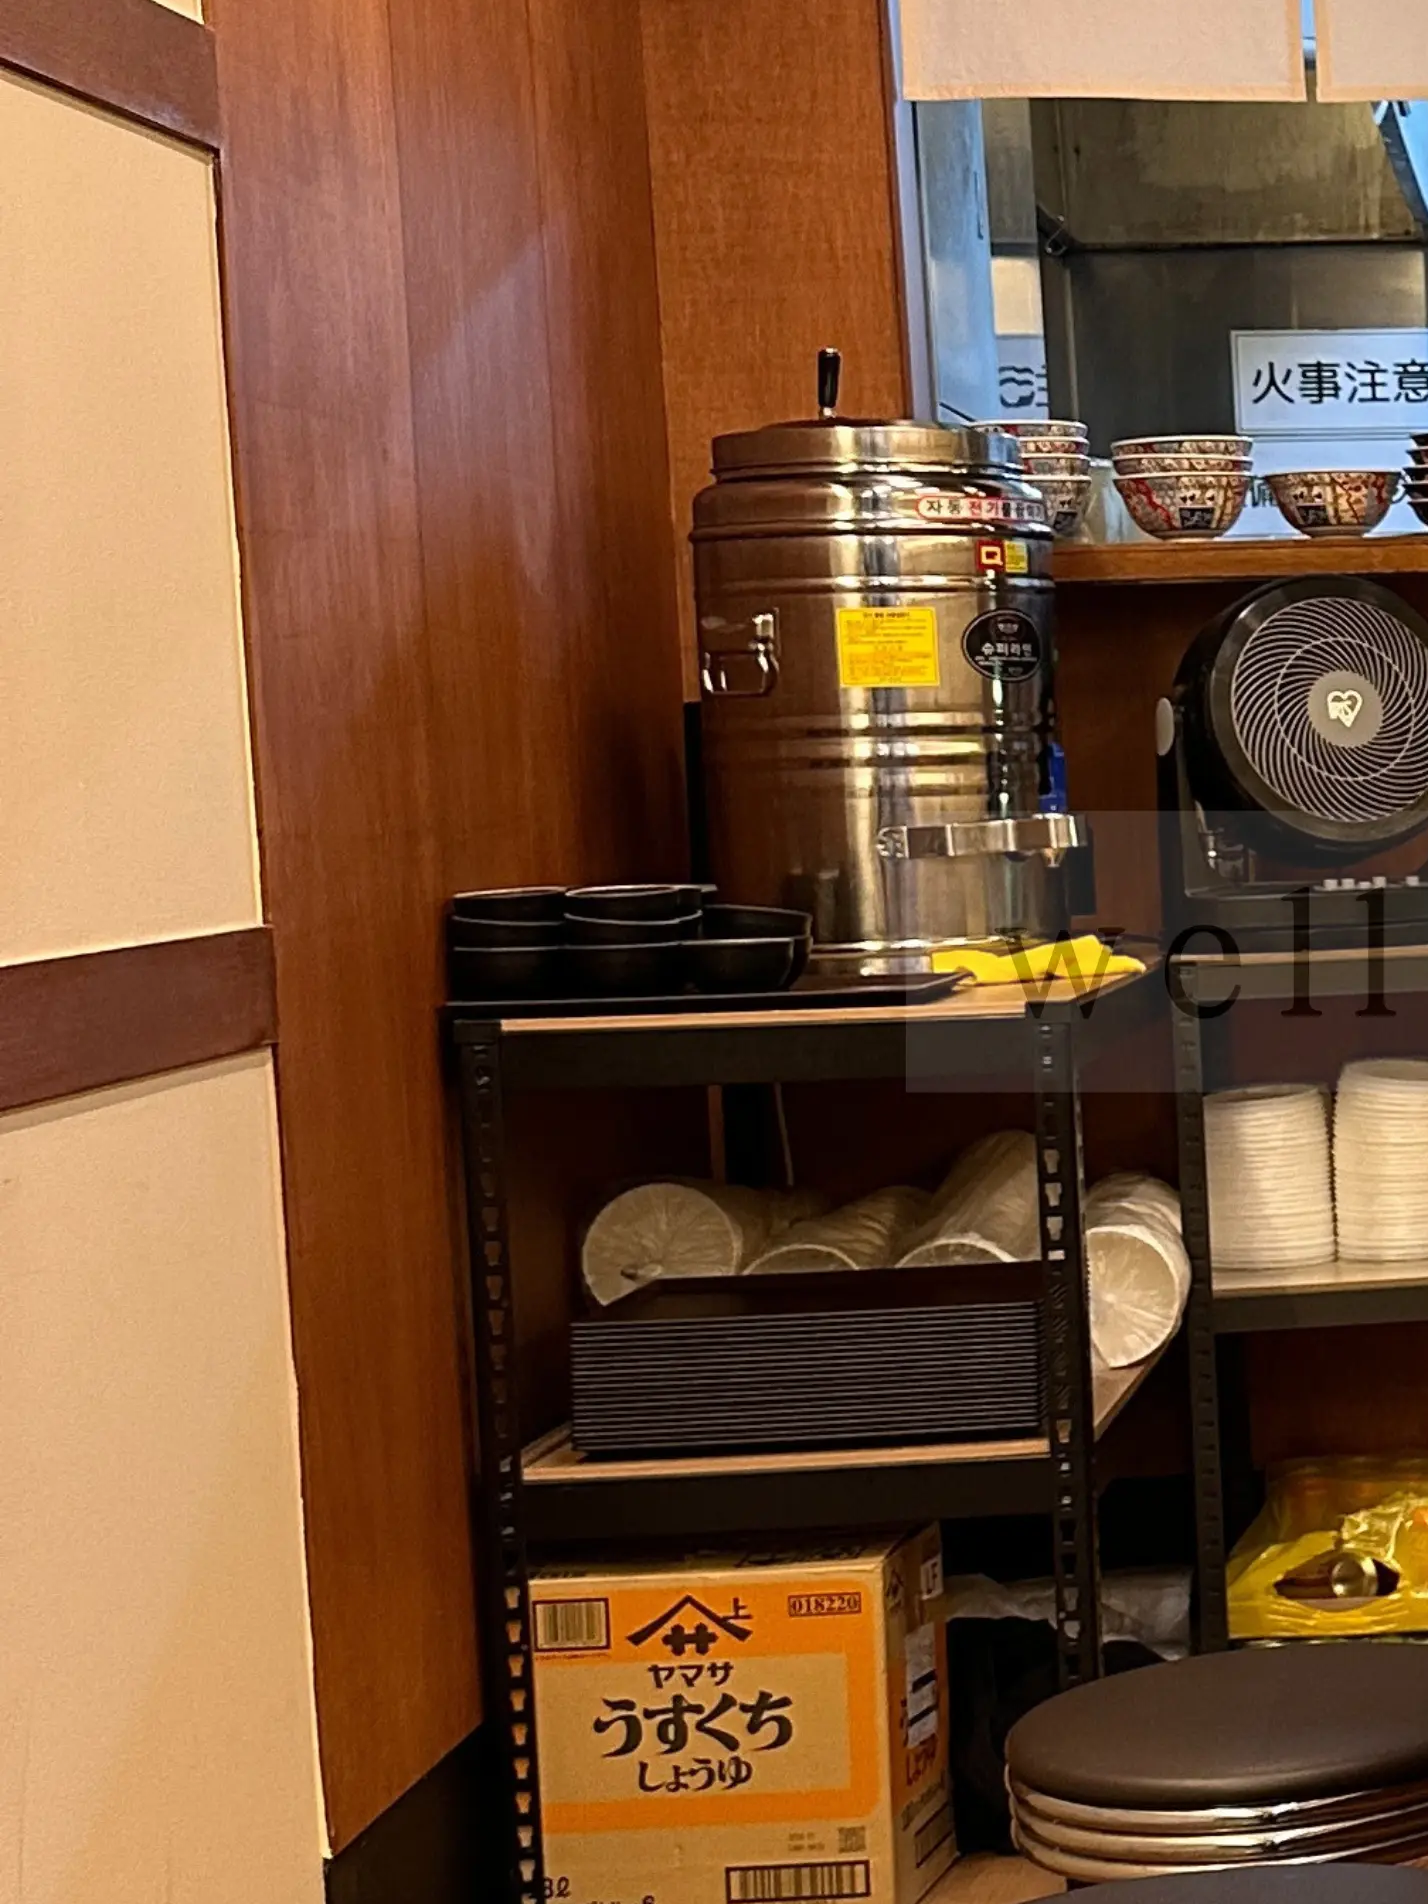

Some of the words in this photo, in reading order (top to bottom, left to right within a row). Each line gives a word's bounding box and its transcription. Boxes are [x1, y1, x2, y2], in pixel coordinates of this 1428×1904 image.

[647, 1661, 734, 1689] ヤマサ
[593, 1690, 793, 1757] うすくち
[637, 1756, 753, 1794] しょうゆ
